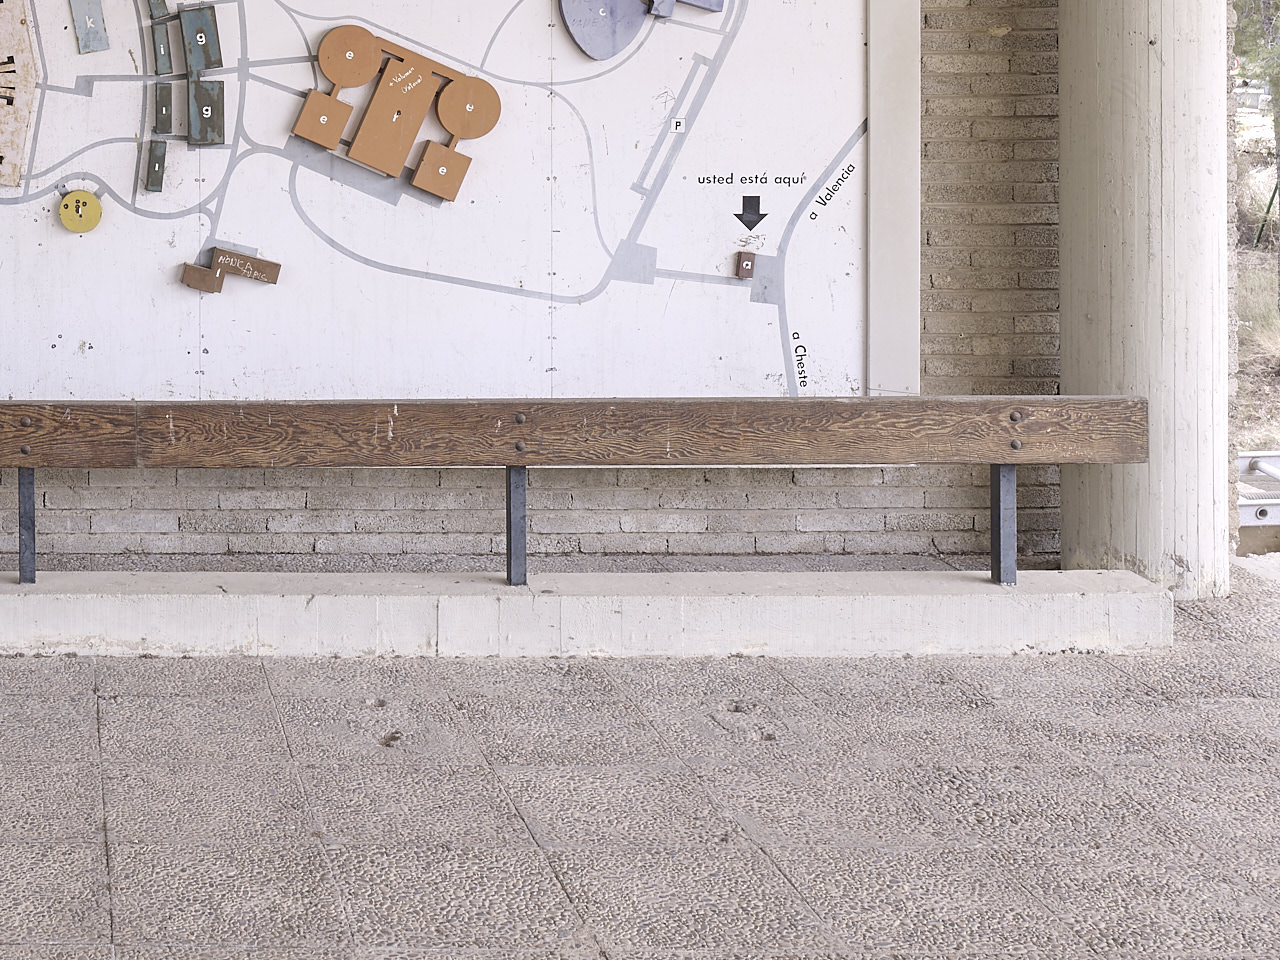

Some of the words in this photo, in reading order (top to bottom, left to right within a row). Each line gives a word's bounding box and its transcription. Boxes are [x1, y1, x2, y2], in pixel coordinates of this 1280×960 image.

[599, 8, 606, 16] c
[86, 16, 95, 28] k
[197, 33, 206, 45] g
[160, 45, 164, 54] i
[345, 51, 354, 60] e
[203, 106, 212, 118] g
[465, 103, 474, 112] e
[320, 115, 328, 124] e
[675, 122, 681, 130] P
[439, 167, 447, 175] e
[698, 173, 734, 184] usted
[740, 172, 768, 184] está
[774, 173, 805, 187] aquí
[810, 211, 818, 220] a
[816, 163, 856, 207] Valencia
[743, 261, 751, 270] a
[792, 332, 800, 340] a
[794, 344, 808, 387] Cheste
